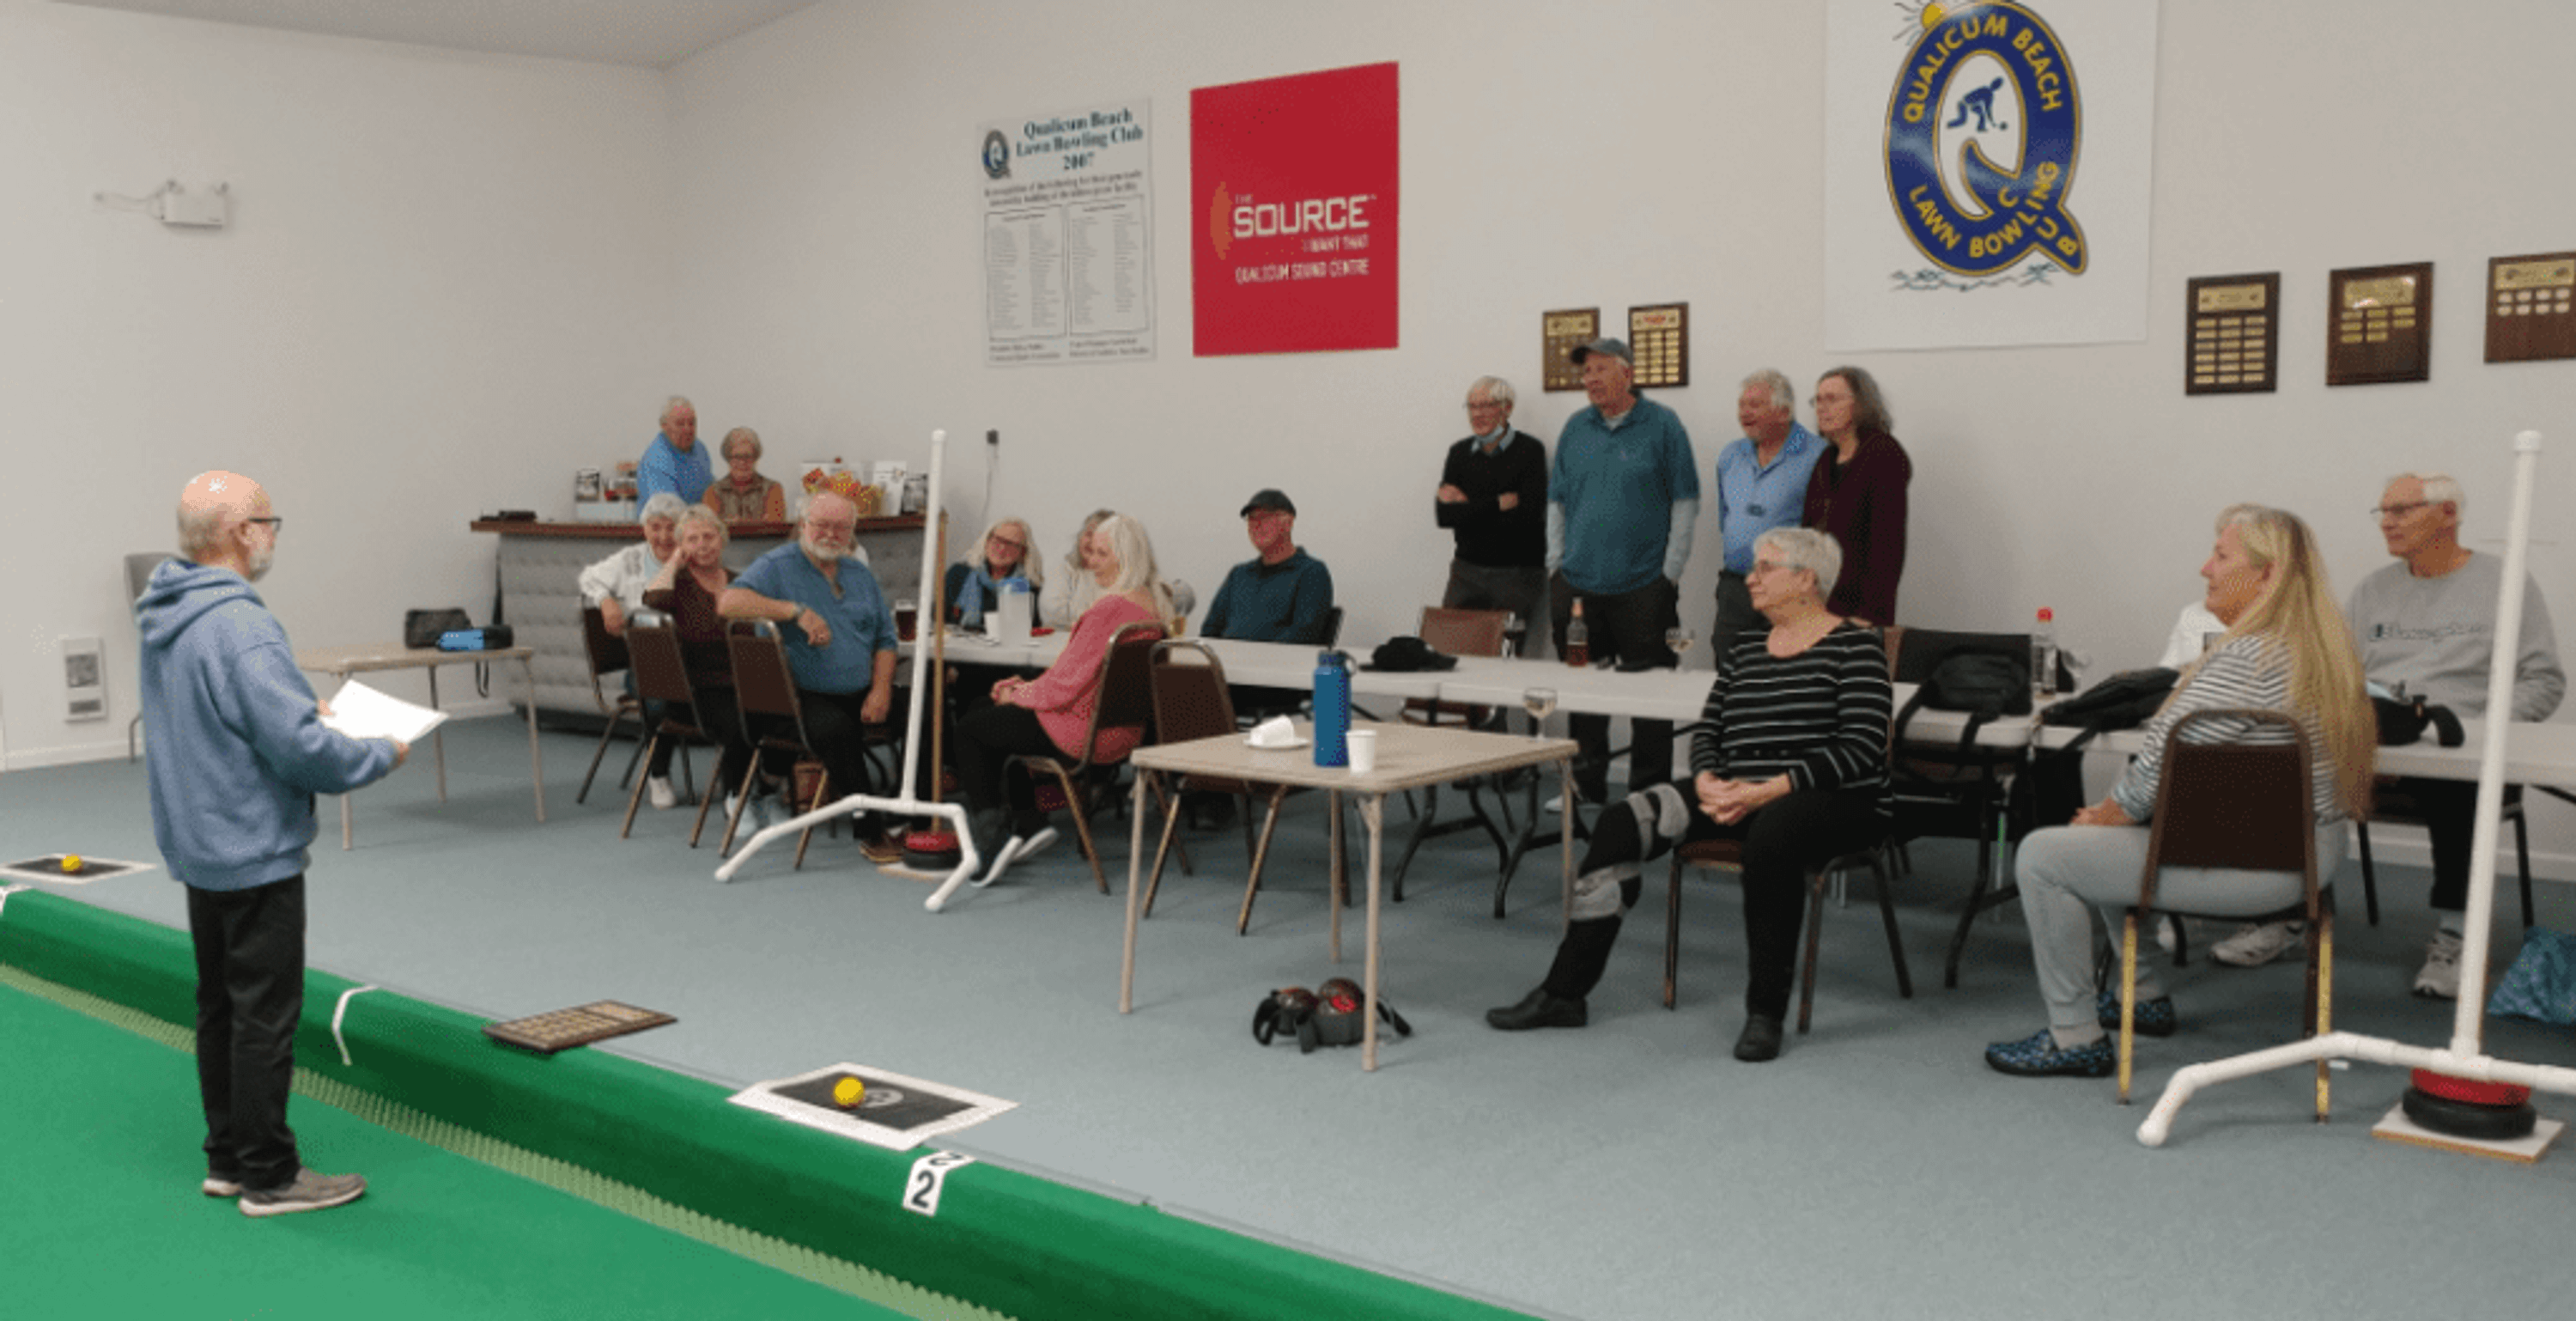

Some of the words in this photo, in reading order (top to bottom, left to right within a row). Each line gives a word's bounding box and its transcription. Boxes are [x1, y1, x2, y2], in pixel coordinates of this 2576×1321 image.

[1903, 14, 2008, 124] QUALICUM
[2012, 27, 2063, 113] BEACH
[1016, 140, 1051, 157] Lawn
[1054, 130, 1109, 151] Bowling
[1110, 124, 1144, 143] Club
[1024, 117, 1088, 140] Qualicum
[1090, 107, 1133, 129] Beach
[1063, 150, 1096, 170] 2007
[1234, 194, 1370, 239] SOURCE
[1909, 184, 1962, 250] LAWN
[1969, 161, 2060, 259] BOWLING
[1235, 263, 1289, 285] QUALICUM
[1329, 258, 1370, 278] CENTRE
[912, 1170, 935, 1208] 2
